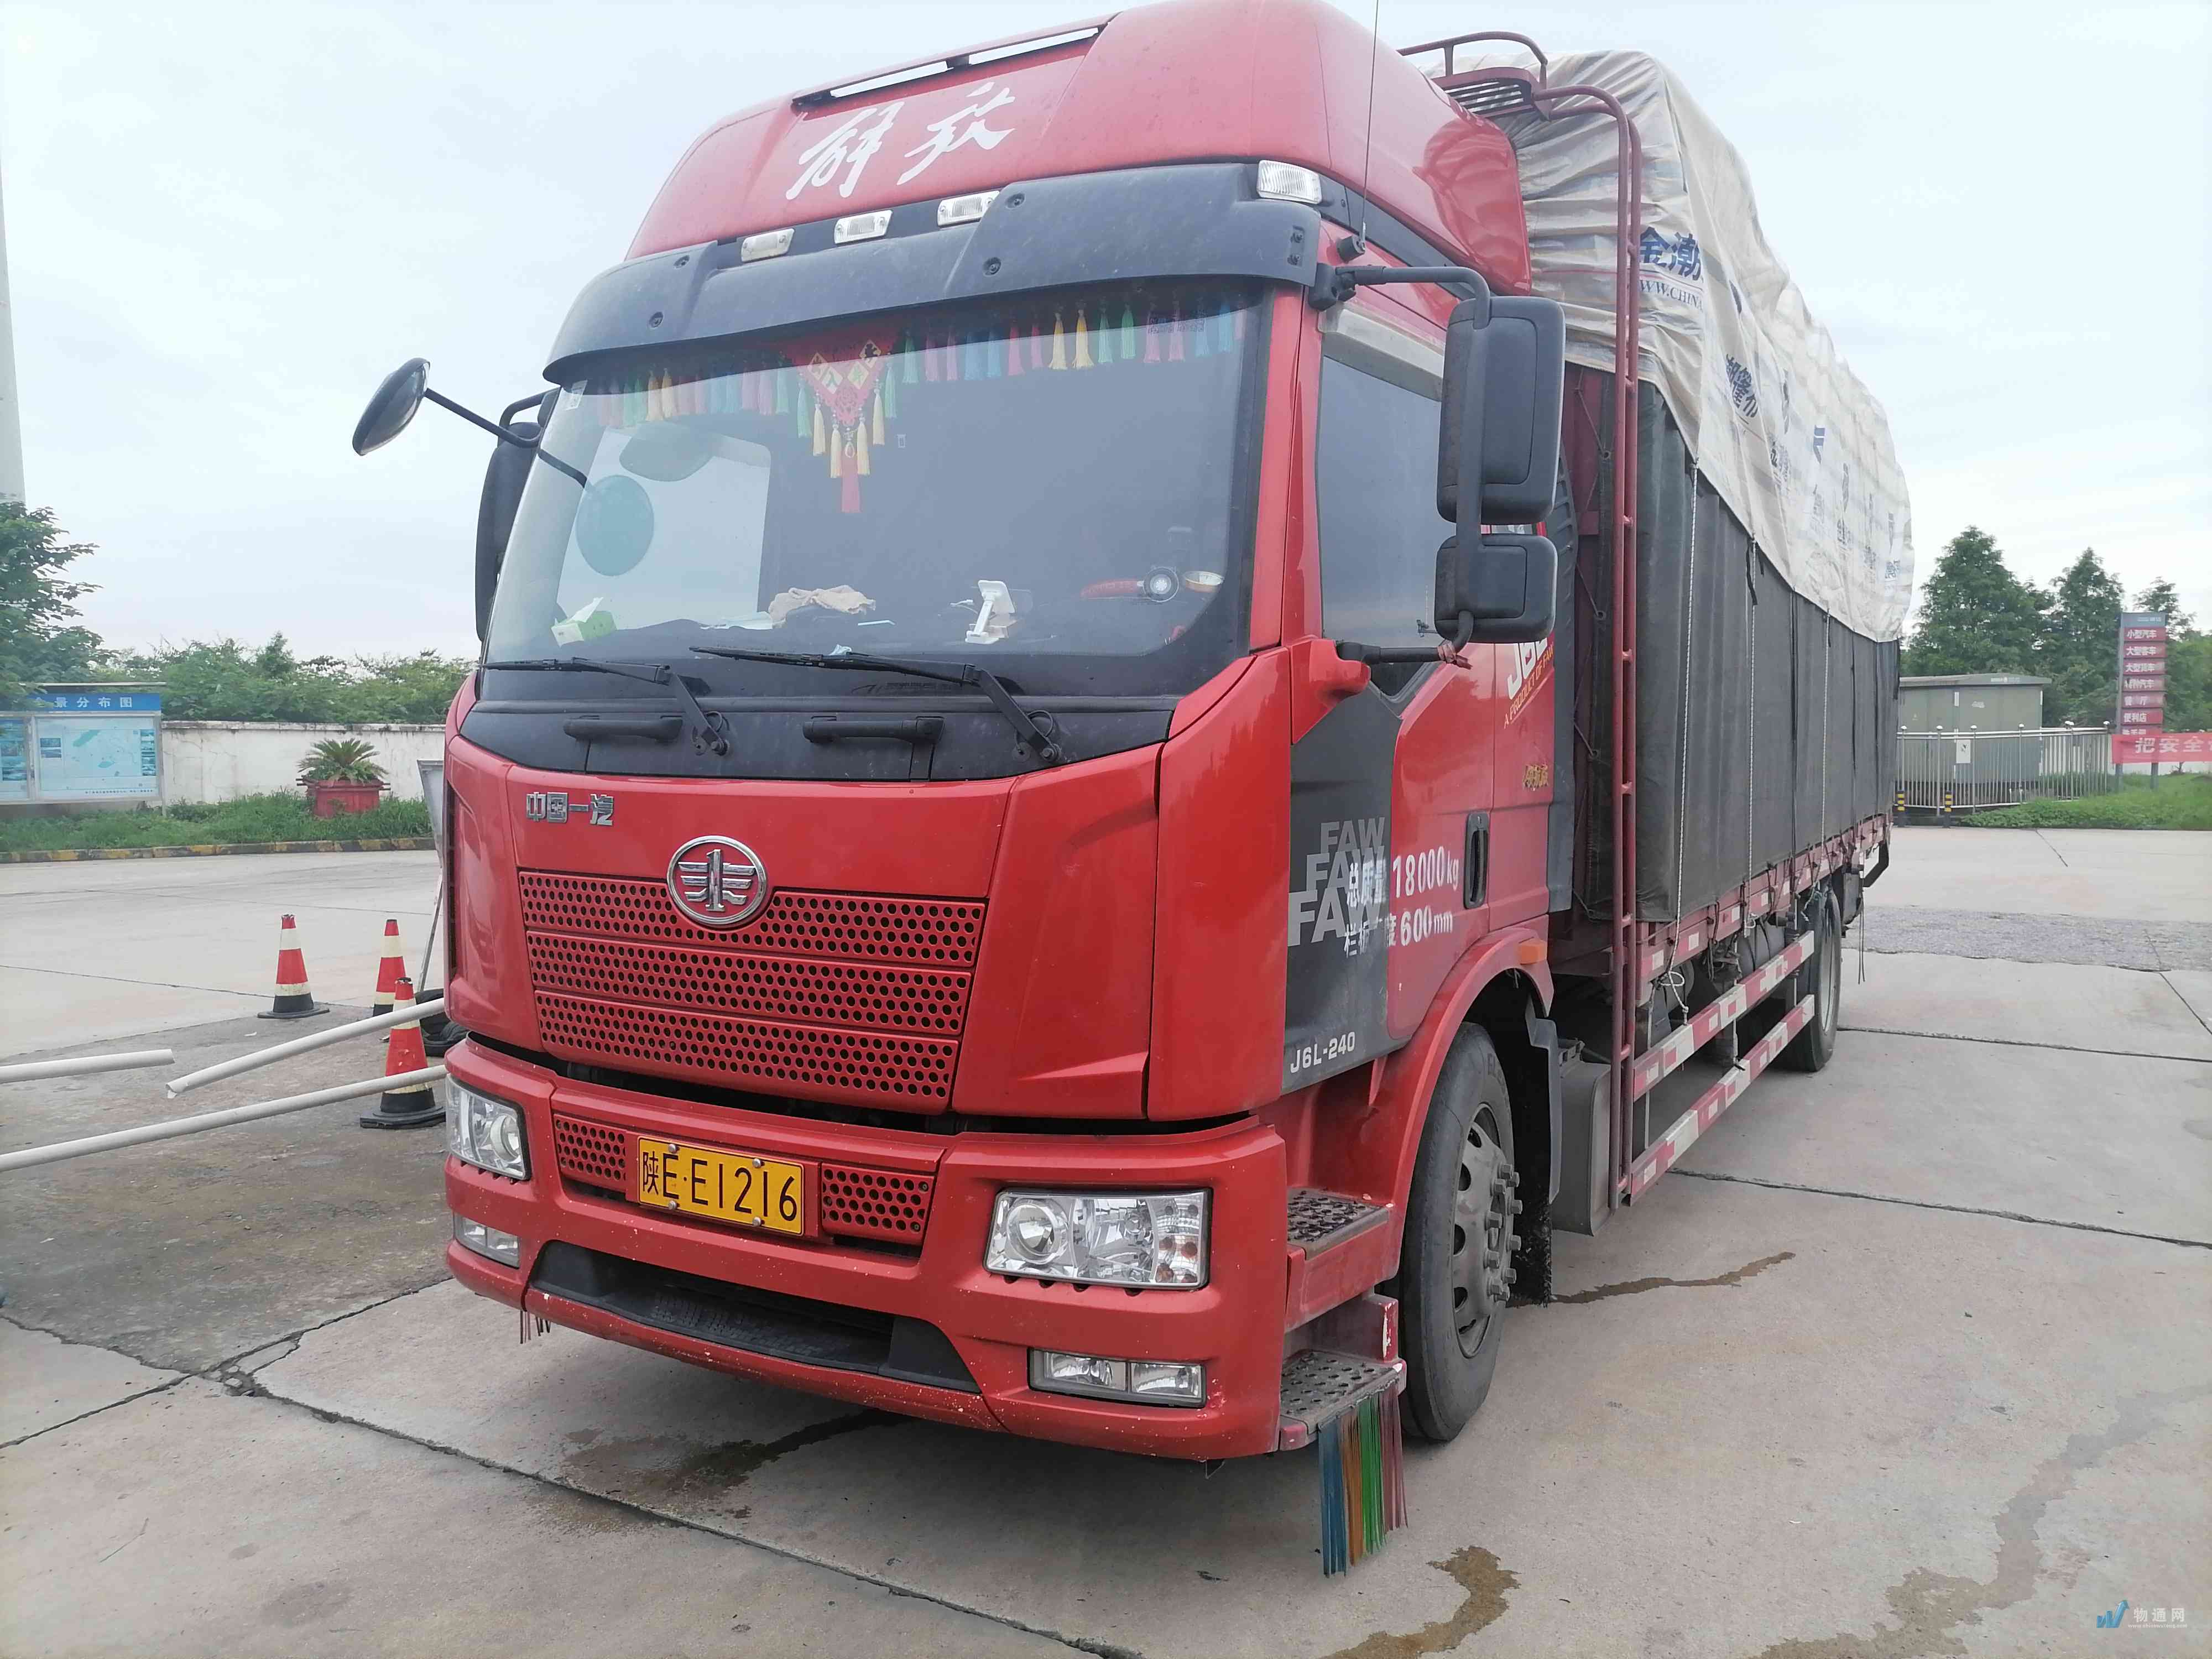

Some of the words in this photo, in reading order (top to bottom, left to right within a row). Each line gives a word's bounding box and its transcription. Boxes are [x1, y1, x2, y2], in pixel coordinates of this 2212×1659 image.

[786, 81, 1015, 200] 解放
[2127, 629, 2157, 639] 小型汽车
[1510, 671, 1535, 720] PRODUCT
[1536, 660, 1543, 681] OF
[2124, 713, 2147, 723] 便利店
[2135, 736, 2212, 754] 把安全
[526, 791, 614, 826] 中国一汽
[1320, 817, 1385, 853] FAW
[1306, 845, 1385, 897] FAW
[1392, 846, 1459, 899] 18000kg
[1287, 885, 1383, 947] FAW
[1344, 913, 1397, 958] 栏板度
[1400, 905, 1453, 947] 600mm
[1290, 1031, 1355, 1073] J6L-240
